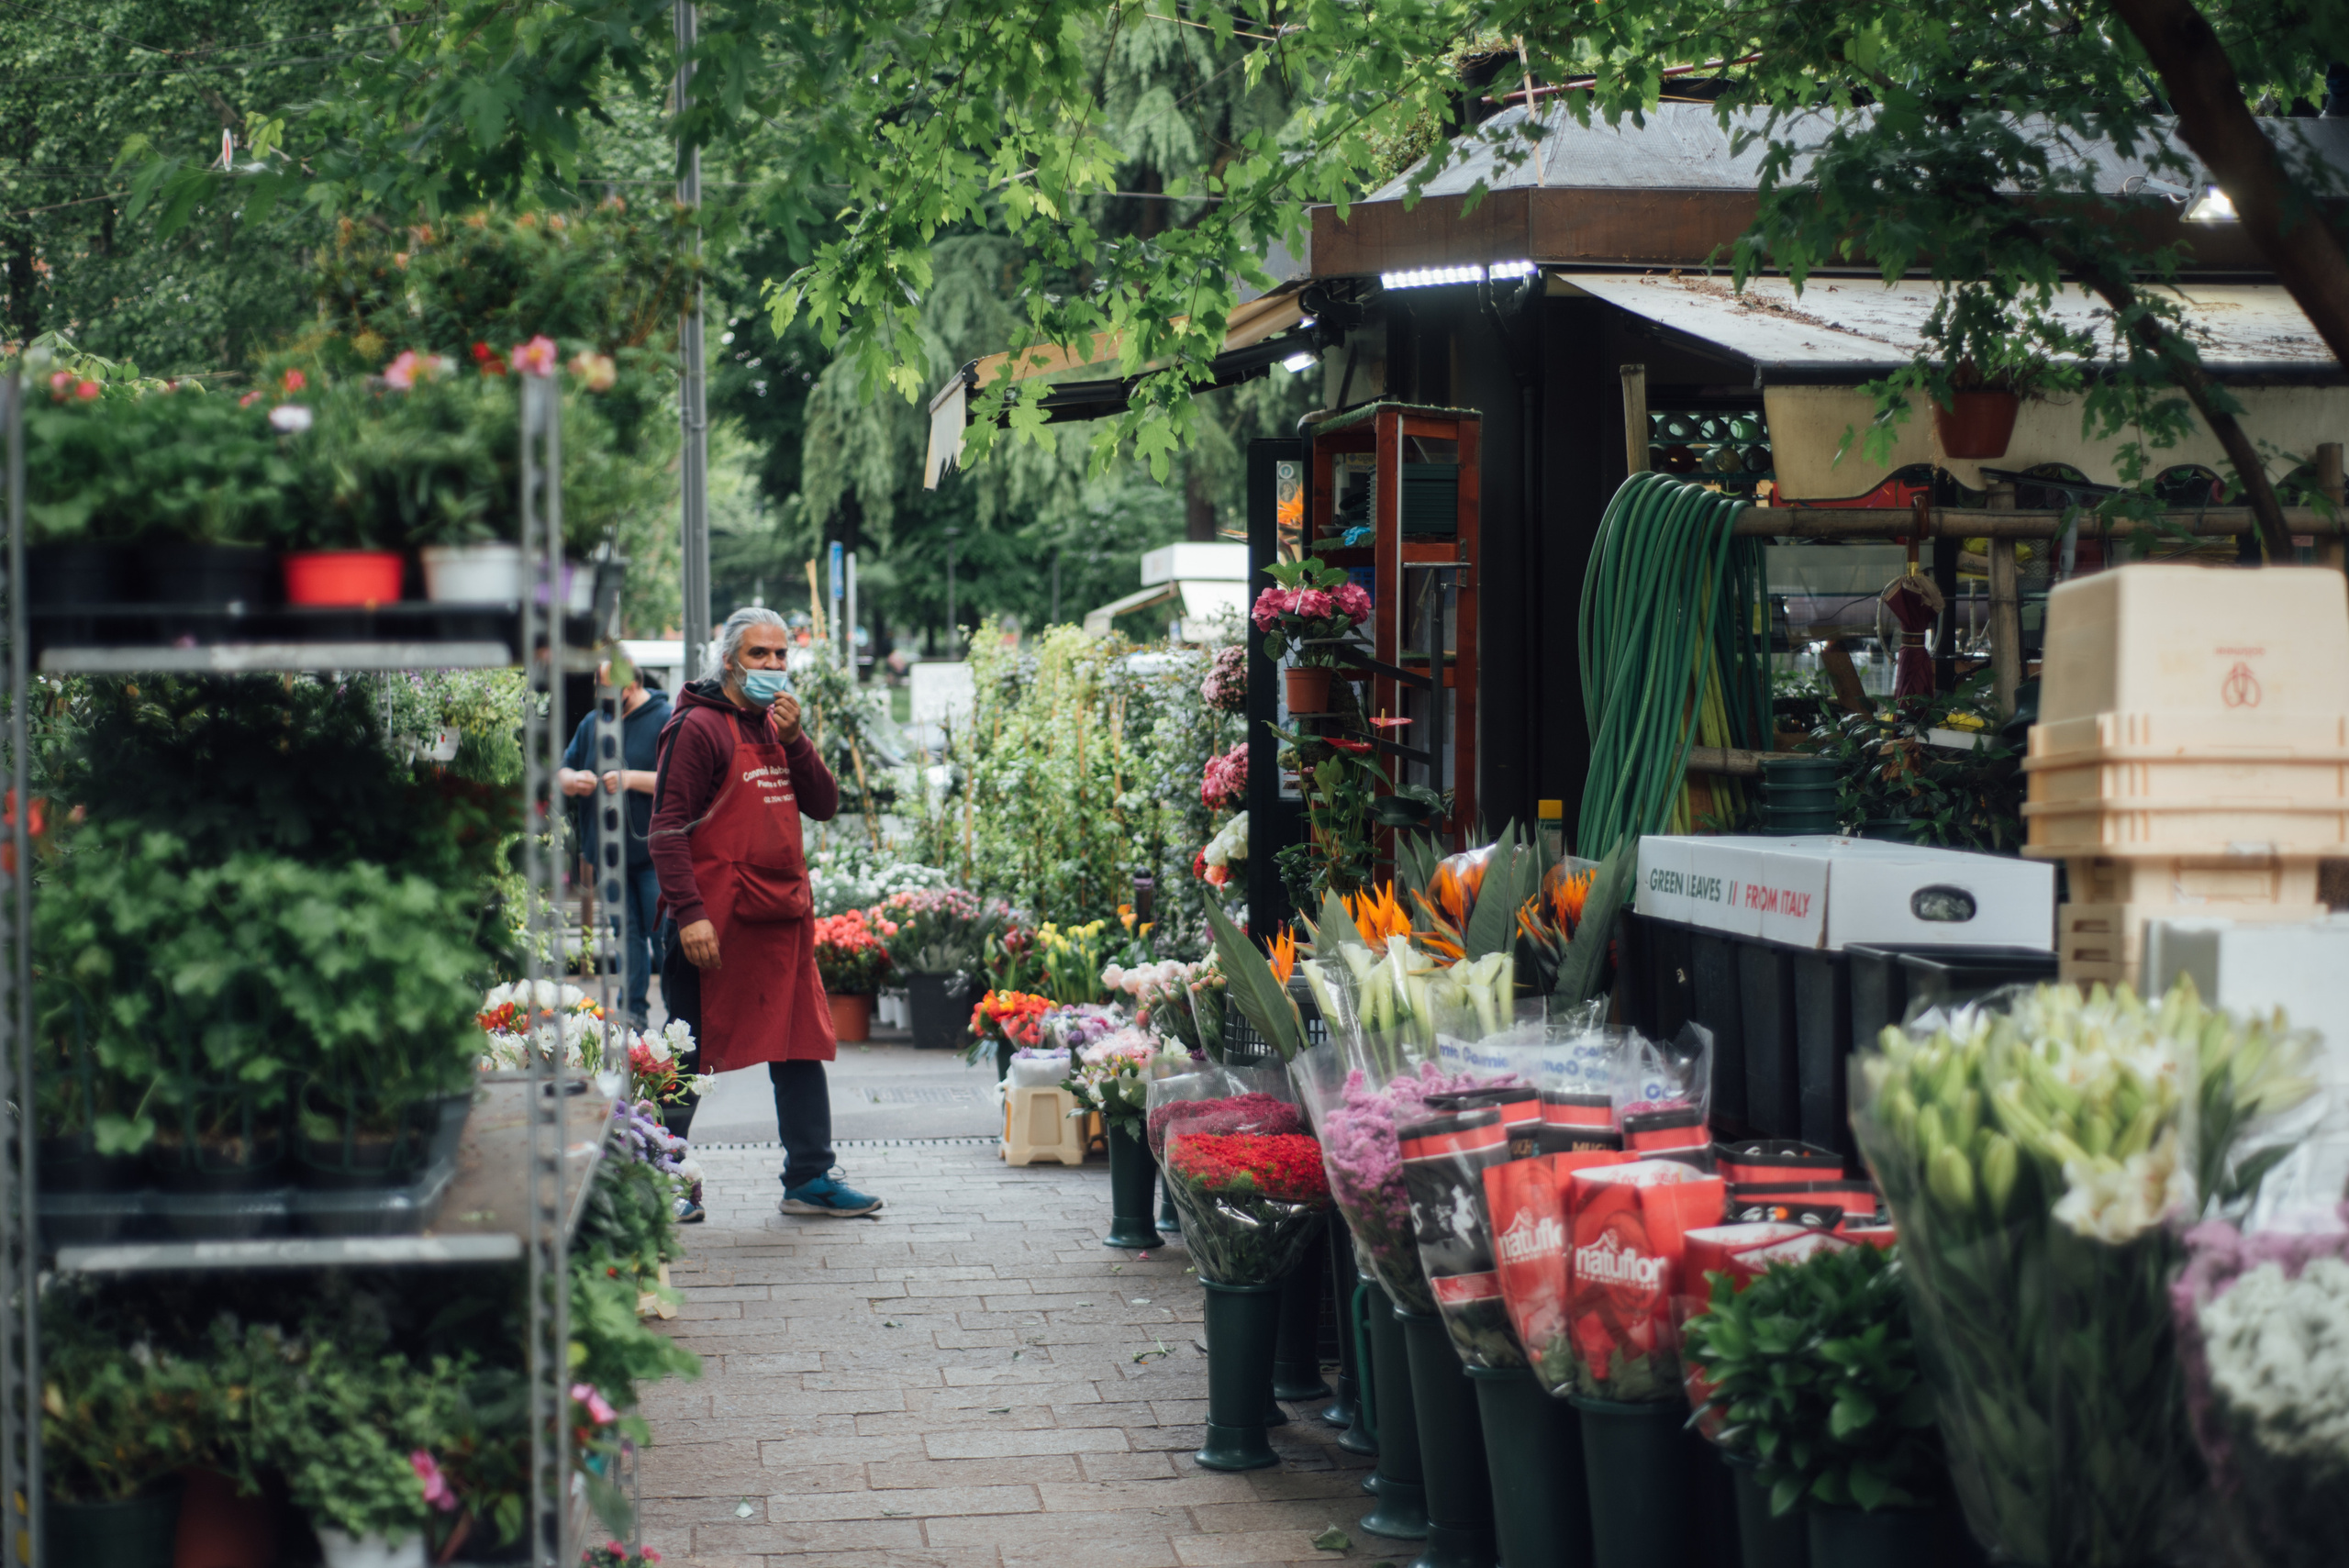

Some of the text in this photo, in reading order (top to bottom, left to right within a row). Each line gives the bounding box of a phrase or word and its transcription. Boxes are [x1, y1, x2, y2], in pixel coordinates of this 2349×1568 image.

[1650, 868, 1683, 895] GREEN
[1686, 873, 1721, 903] LEAVES
[1745, 884, 1777, 913] FROM
[1781, 889, 1811, 918] ITALY
[1575, 1245, 1667, 1284] natuflor
